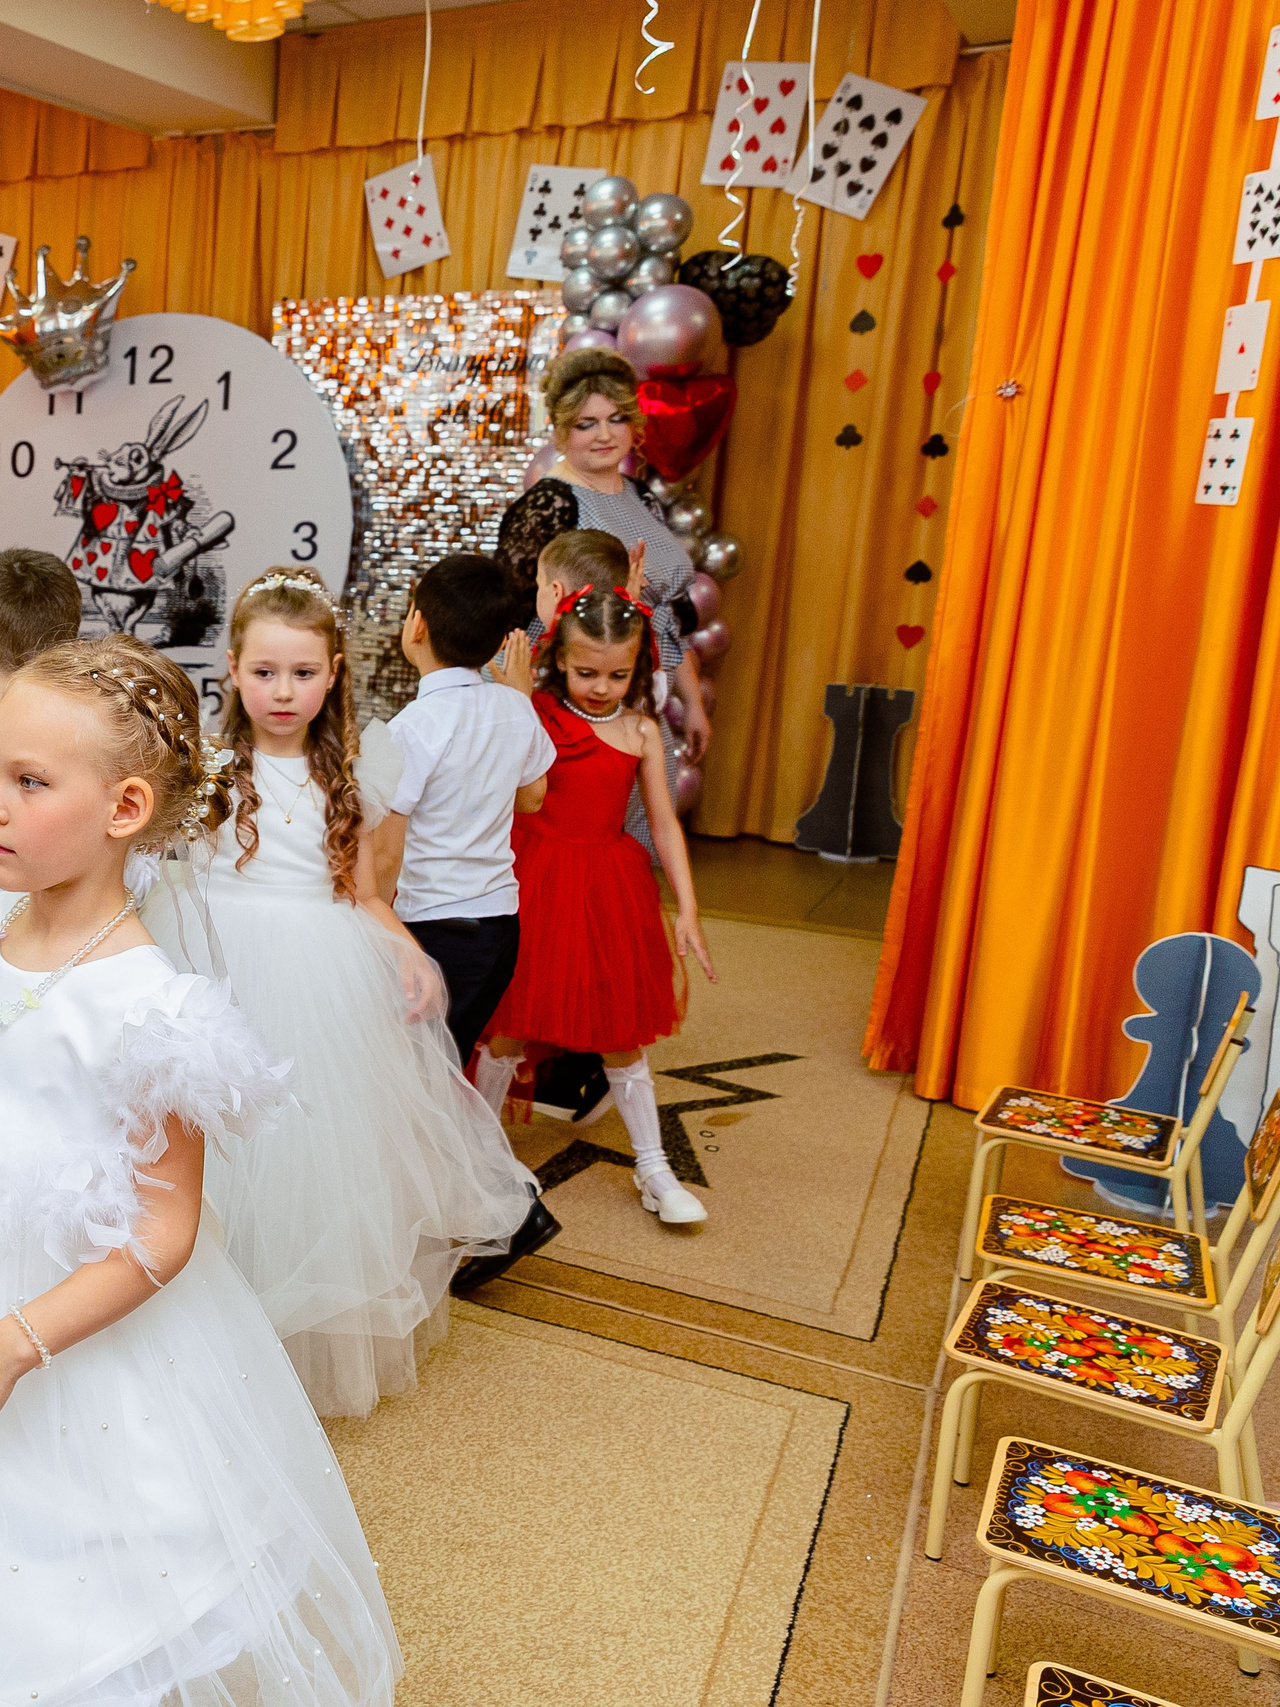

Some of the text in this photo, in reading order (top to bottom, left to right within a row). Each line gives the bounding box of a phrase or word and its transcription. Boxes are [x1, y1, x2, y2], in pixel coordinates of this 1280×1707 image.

[123, 344, 175, 385] 12
[217, 370, 232, 411] 1
[270, 429, 298, 470] 2
[291, 521, 318, 562] 3
[201, 677, 224, 716] 5
